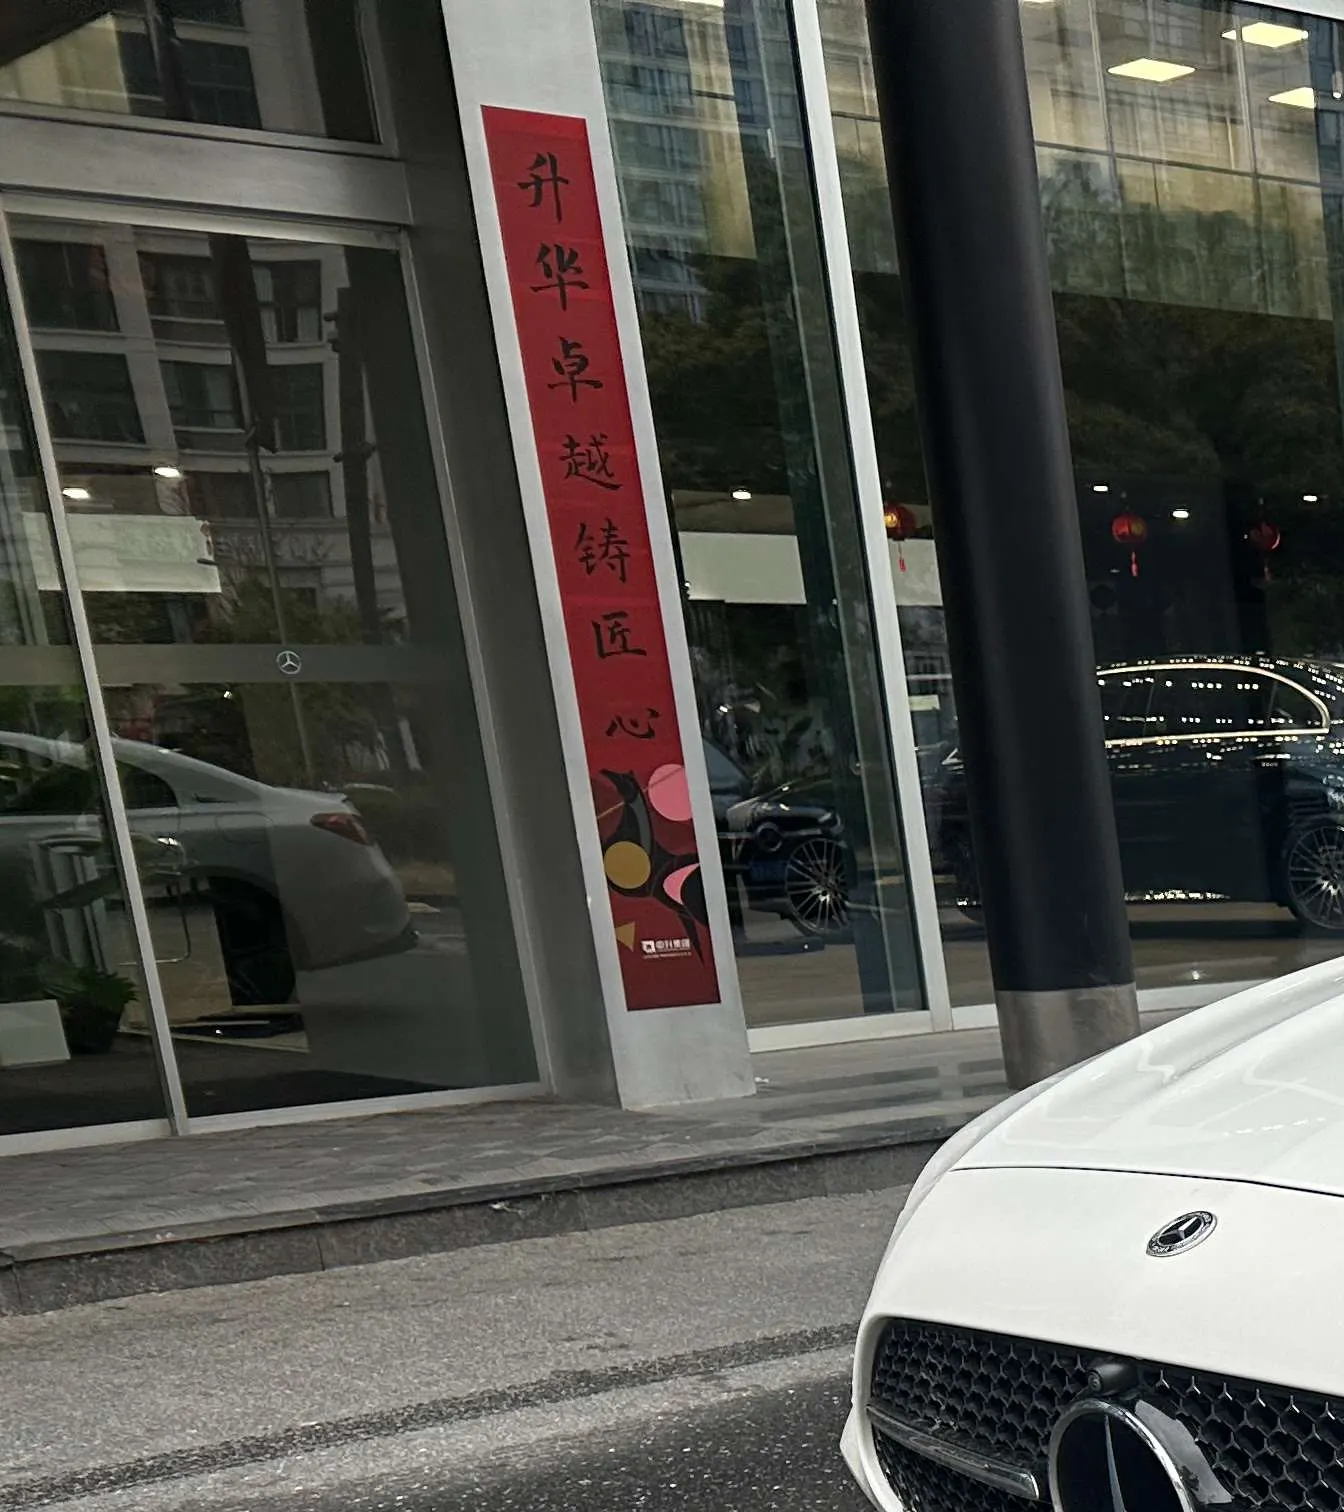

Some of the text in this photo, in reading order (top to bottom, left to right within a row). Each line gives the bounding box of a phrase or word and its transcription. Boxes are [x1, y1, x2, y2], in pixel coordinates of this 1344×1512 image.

[518, 152, 660, 740] 升华卓越铸匠心
